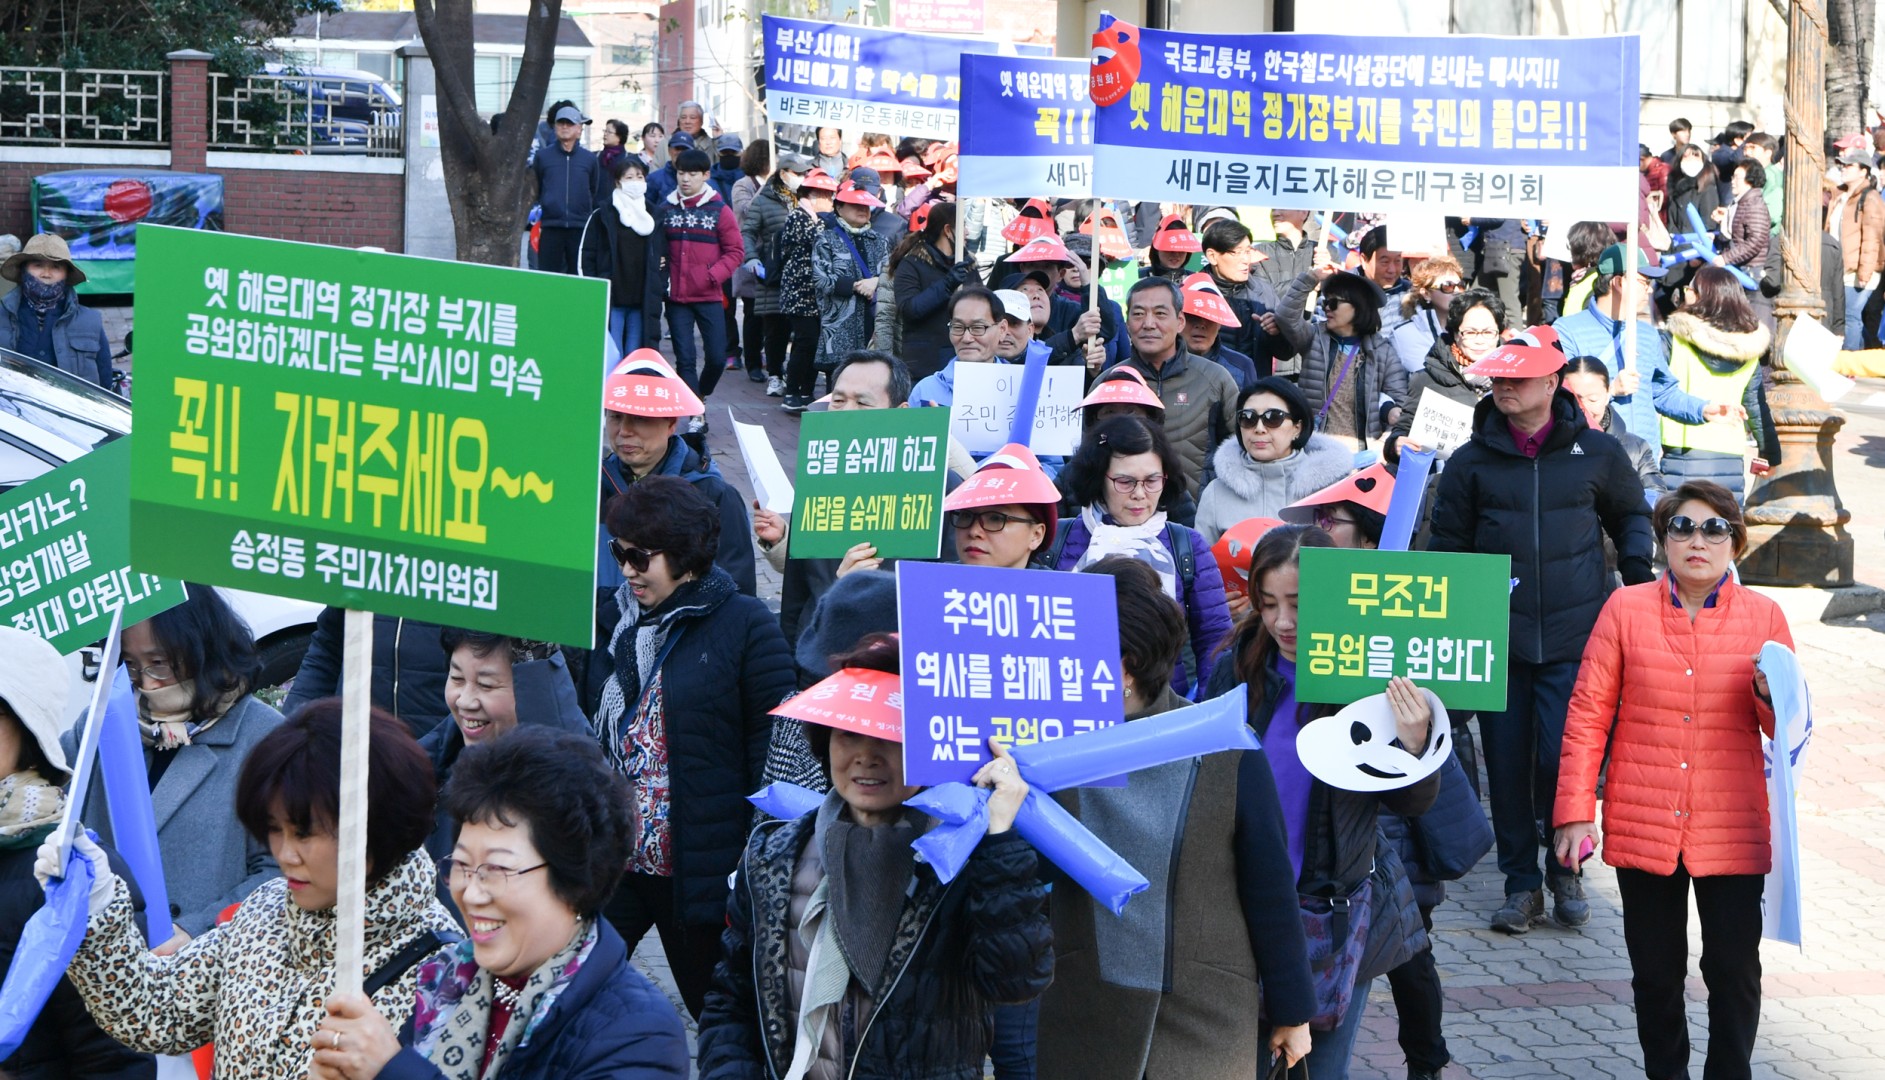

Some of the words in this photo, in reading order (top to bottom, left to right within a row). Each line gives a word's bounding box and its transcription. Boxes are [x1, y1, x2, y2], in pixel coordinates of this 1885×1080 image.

[775, 27, 860, 62] 부산시여!
[1164, 41, 1257, 82] 국토교통부,
[1264, 50, 1425, 88] 한국철도시설공단에
[1429, 55, 1484, 89] 보내는
[772, 57, 849, 90] 시민에게
[855, 66, 875, 93] 한
[881, 70, 938, 100] 약속을
[1000, 70, 1014, 97] 옛
[1015, 71, 1067, 100] 해운대역
[1034, 107, 1091, 145] 꼭!!
[1129, 81, 1151, 131] 옛
[1160, 82, 1251, 138] 해운대역
[1262, 90, 1401, 145] 정거장부지를
[1411, 98, 1481, 148] 주민의
[1492, 99, 1588, 151] 품으로!!
[1046, 162, 1090, 187] 새마
[1166, 158, 1544, 206] 새마을지도자해운대구협의회
[204, 266, 229, 309] 옛
[237, 269, 341, 324] 해운대역
[350, 285, 430, 335] 정거장
[437, 295, 518, 347] 부지를
[185, 312, 364, 377] 공원화하겠다는
[373, 337, 479, 393] 부산시의
[489, 353, 543, 401] 약속
[612, 384, 680, 403] 공원화!
[957, 403, 999, 433] 주민
[169, 376, 241, 502] 꼭!!
[271, 391, 554, 544] 지켜주세요~~
[806, 439, 840, 475] 땅을
[845, 437, 897, 474] 숨쉬게
[902, 435, 938, 472] 하고
[0, 478, 89, 550] 라카노?
[800, 496, 846, 532] 사람을
[850, 494, 897, 531] 숨쉬게
[900, 493, 933, 530] 하자
[230, 529, 306, 578] 송정동
[314, 541, 499, 611] 주민자치위원회
[943, 588, 1019, 638] 추억이
[1026, 594, 1076, 641] 깃든
[1347, 572, 1449, 619] 무조건
[915, 651, 993, 699] 역사를
[1001, 653, 1052, 701] 함께
[1058, 656, 1084, 702] 할
[1091, 659, 1116, 703] 수
[1308, 632, 1395, 679] 공원을
[1405, 636, 1495, 683] 원한다
[929, 715, 981, 762] 있는
